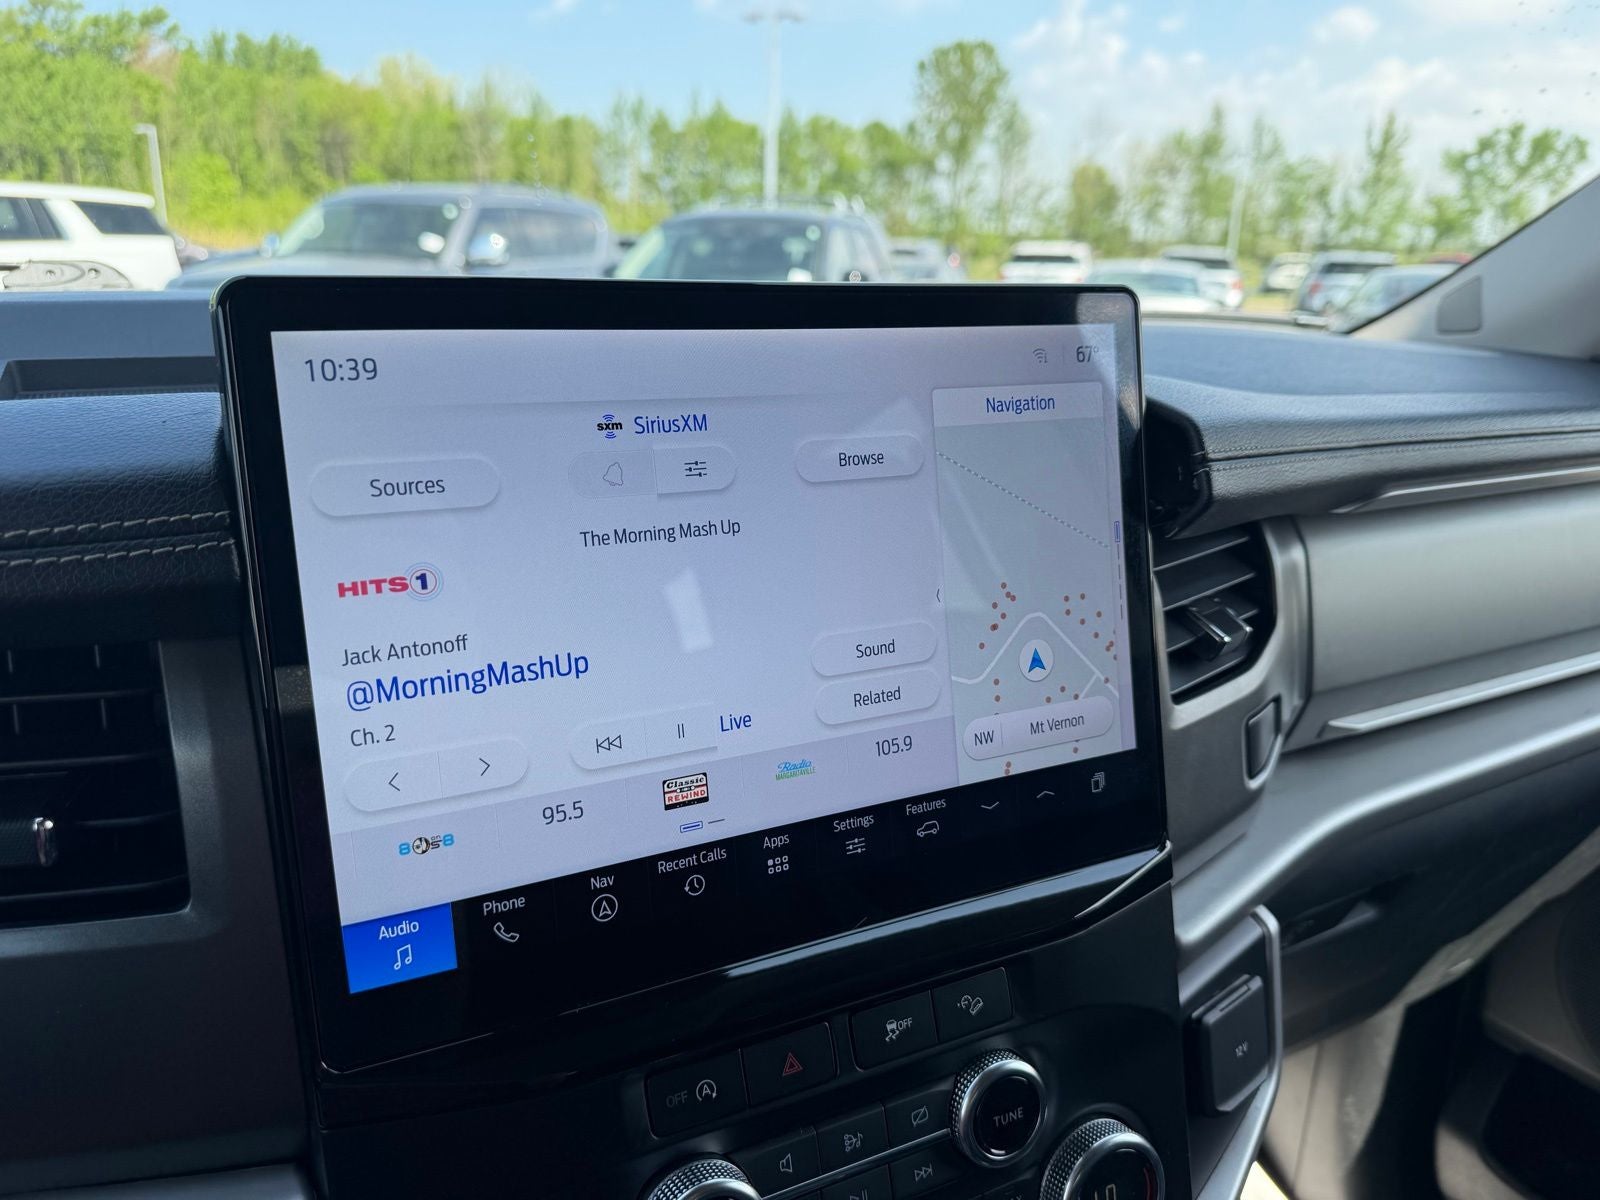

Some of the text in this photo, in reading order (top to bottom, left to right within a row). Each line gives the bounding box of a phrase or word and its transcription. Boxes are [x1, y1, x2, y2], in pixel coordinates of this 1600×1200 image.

[305, 358, 378, 382] 10:39
[986, 395, 1055, 415] Navigation
[634, 413, 708, 435] SiriusXM
[838, 451, 884, 467] Browse
[370, 476, 445, 498] Sources
[580, 519, 741, 547] The Morning Mash Up
[342, 634, 468, 667] Jack Antonoff
[856, 638, 896, 659] Sound
[347, 652, 589, 712] @MorningMashUp
[854, 686, 901, 708] Related
[720, 714, 752, 733] Live
[1030, 714, 1085, 736] Mt Vernon
[351, 724, 396, 747] Ch. 2
[876, 734, 913, 757] 105.9
[974, 730, 994, 747] NW
[666, 776, 705, 790] Classic
[667, 789, 706, 804] REWIND
[905, 798, 946, 816] Features
[542, 800, 584, 825] 95.5
[833, 813, 874, 833] Settings
[763, 833, 790, 850] Apps
[657, 848, 727, 874] Recent Calls
[590, 874, 615, 890] Nav
[483, 895, 526, 916] Phone
[378, 918, 420, 941] Audio
[898, 1017, 913, 1031] OFF
[665, 1090, 688, 1108] OFF
[993, 1106, 1024, 1128] TUNE
